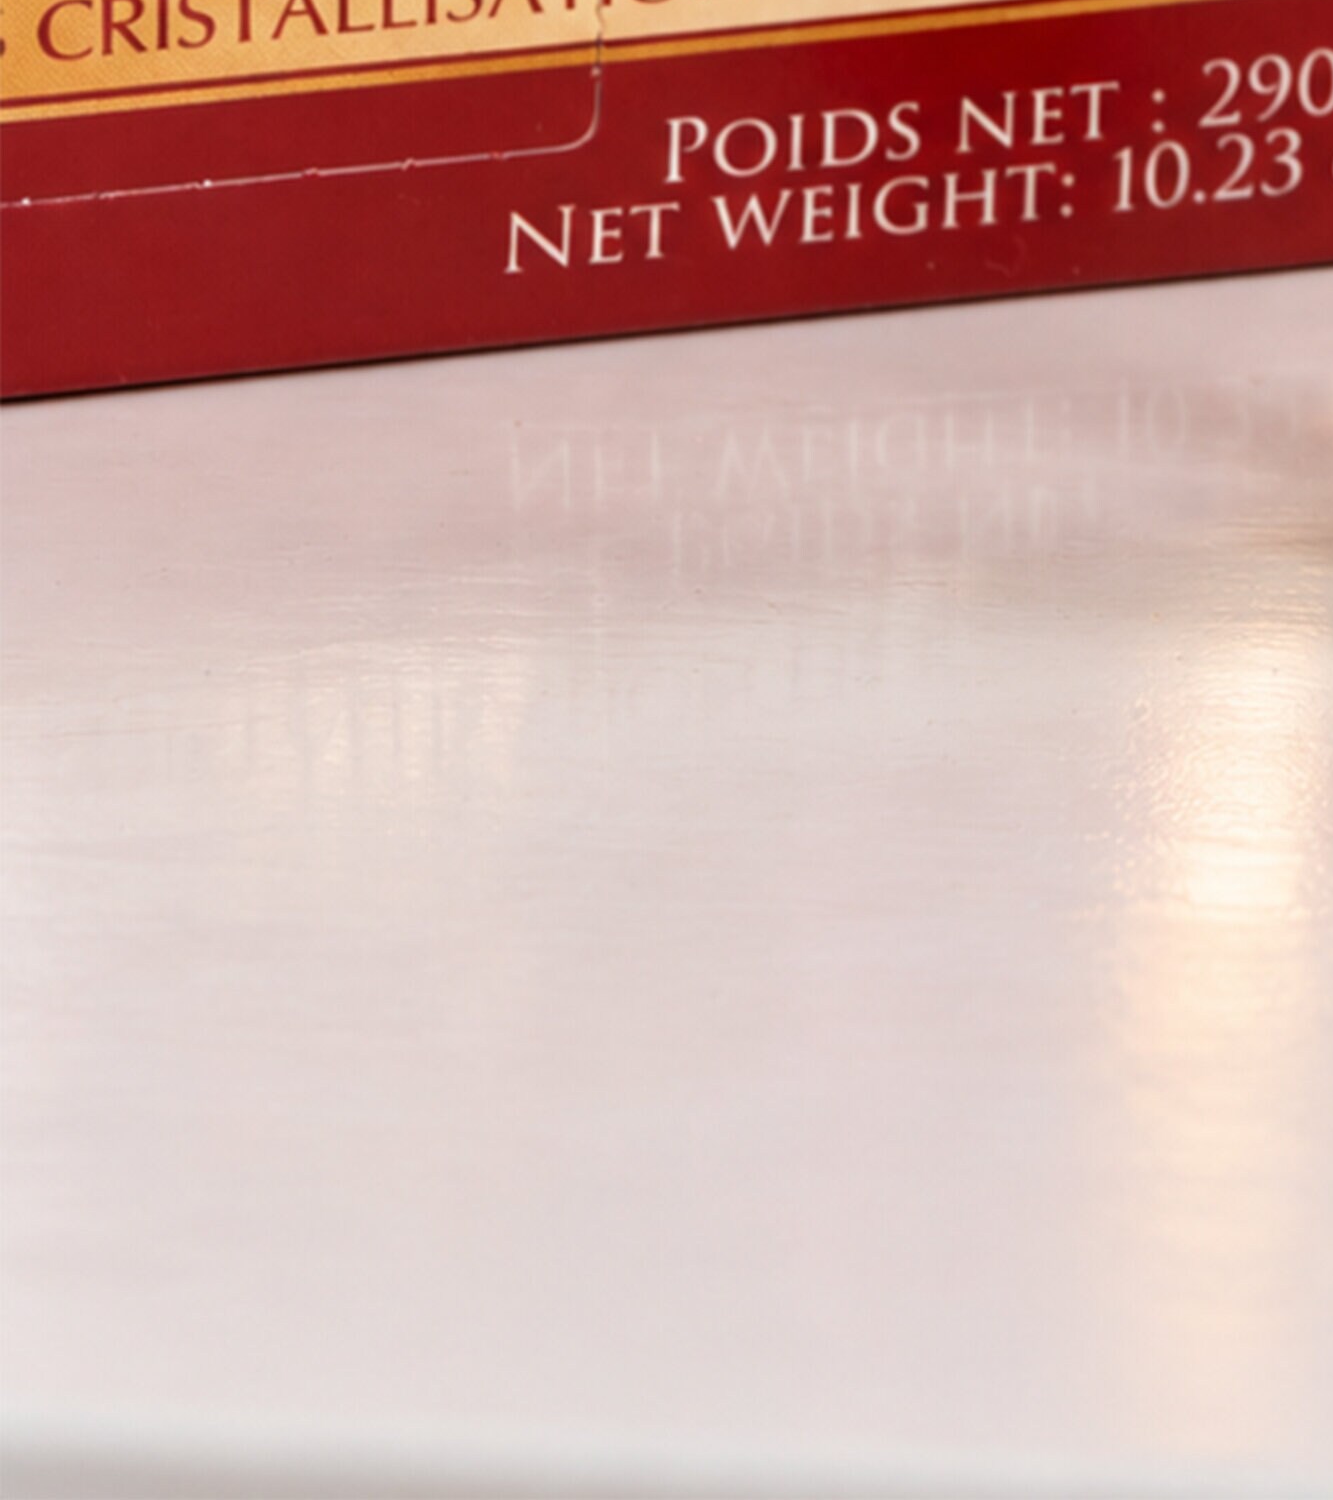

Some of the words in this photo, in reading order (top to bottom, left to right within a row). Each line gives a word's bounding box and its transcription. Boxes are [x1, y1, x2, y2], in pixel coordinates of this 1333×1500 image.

[663, 101, 921, 184] POIDS
[954, 80, 1120, 156] NET
[503, 202, 680, 275] NET
[713, 160, 1076, 250] WEIGHT:
[1110, 127, 1302, 215] 10.23
